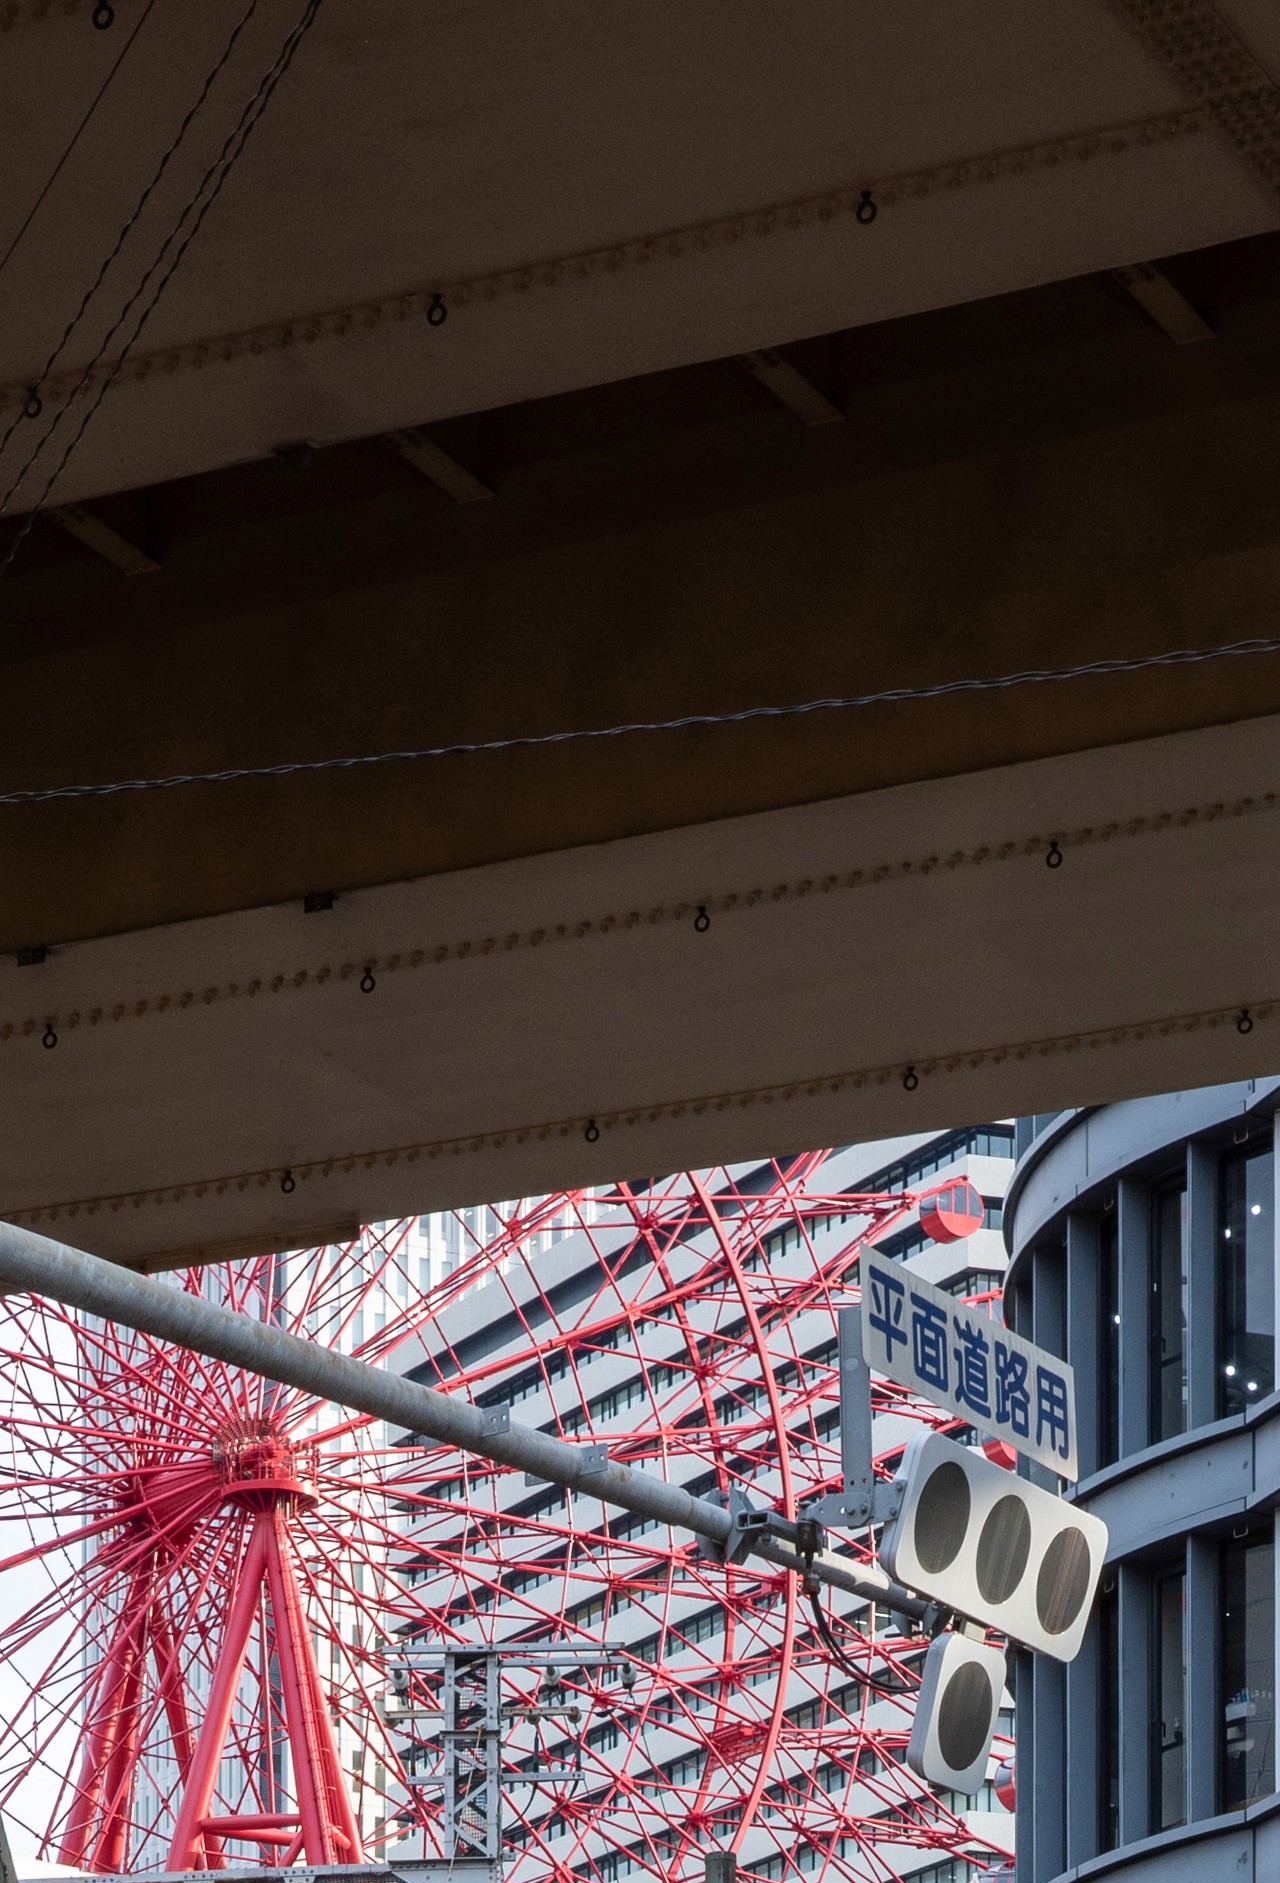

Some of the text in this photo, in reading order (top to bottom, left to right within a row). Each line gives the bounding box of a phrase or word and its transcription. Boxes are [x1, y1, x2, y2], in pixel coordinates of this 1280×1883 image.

[868, 1264, 1071, 1461] 平面道路用
